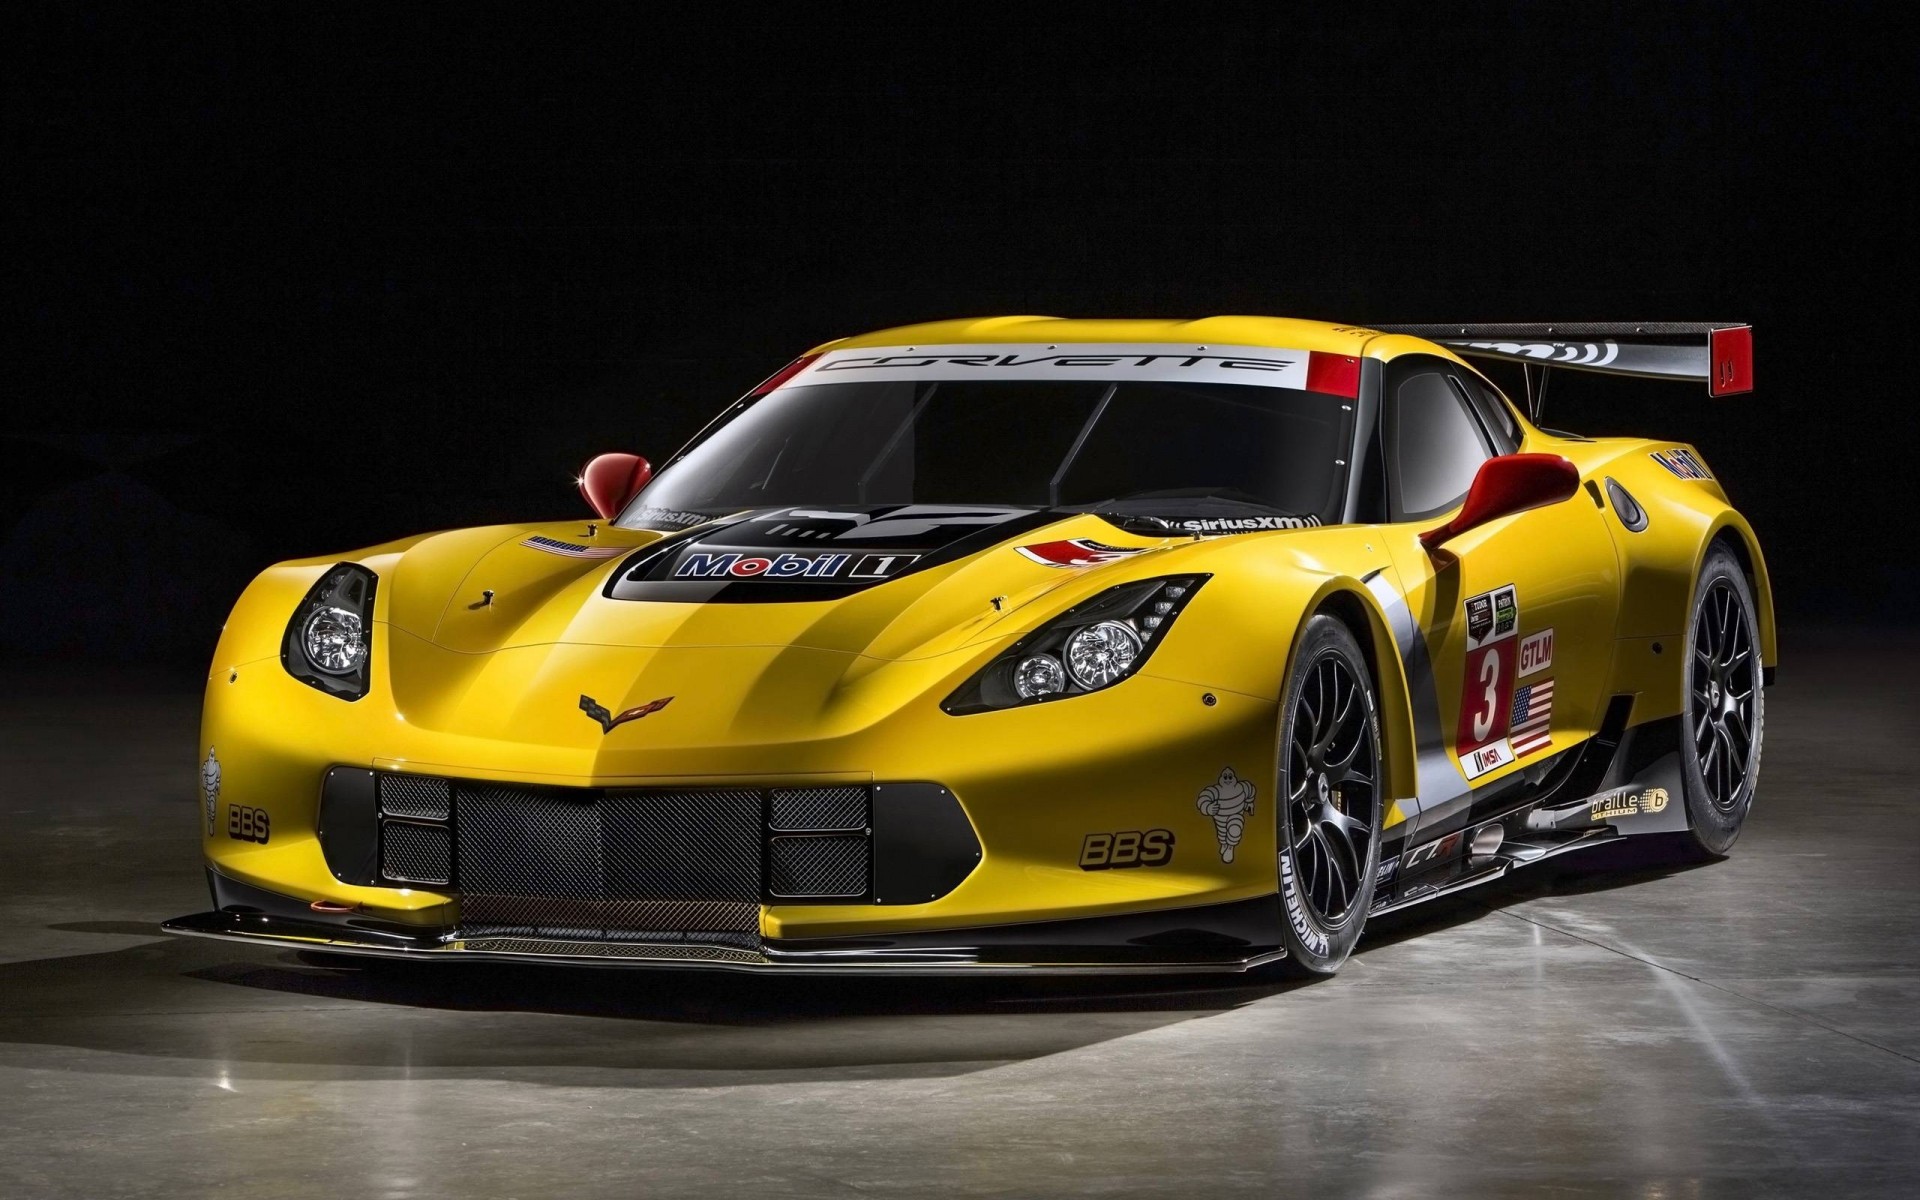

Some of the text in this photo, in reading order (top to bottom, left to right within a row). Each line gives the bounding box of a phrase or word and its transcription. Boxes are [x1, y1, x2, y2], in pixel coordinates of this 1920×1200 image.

[815, 353, 1297, 373] CORVETTE
[675, 554, 852, 578] Mobil
[1521, 635, 1552, 671] GTLM
[1473, 648, 1500, 742] 3
[1482, 748, 1502, 767] IMSA
[1591, 791, 1638, 814] braille
[1591, 808, 1637, 820] LITHIUM
[229, 804, 270, 844] BBS
[1079, 829, 1175, 872] BBS
[1281, 855, 1319, 951] MICHELIN
